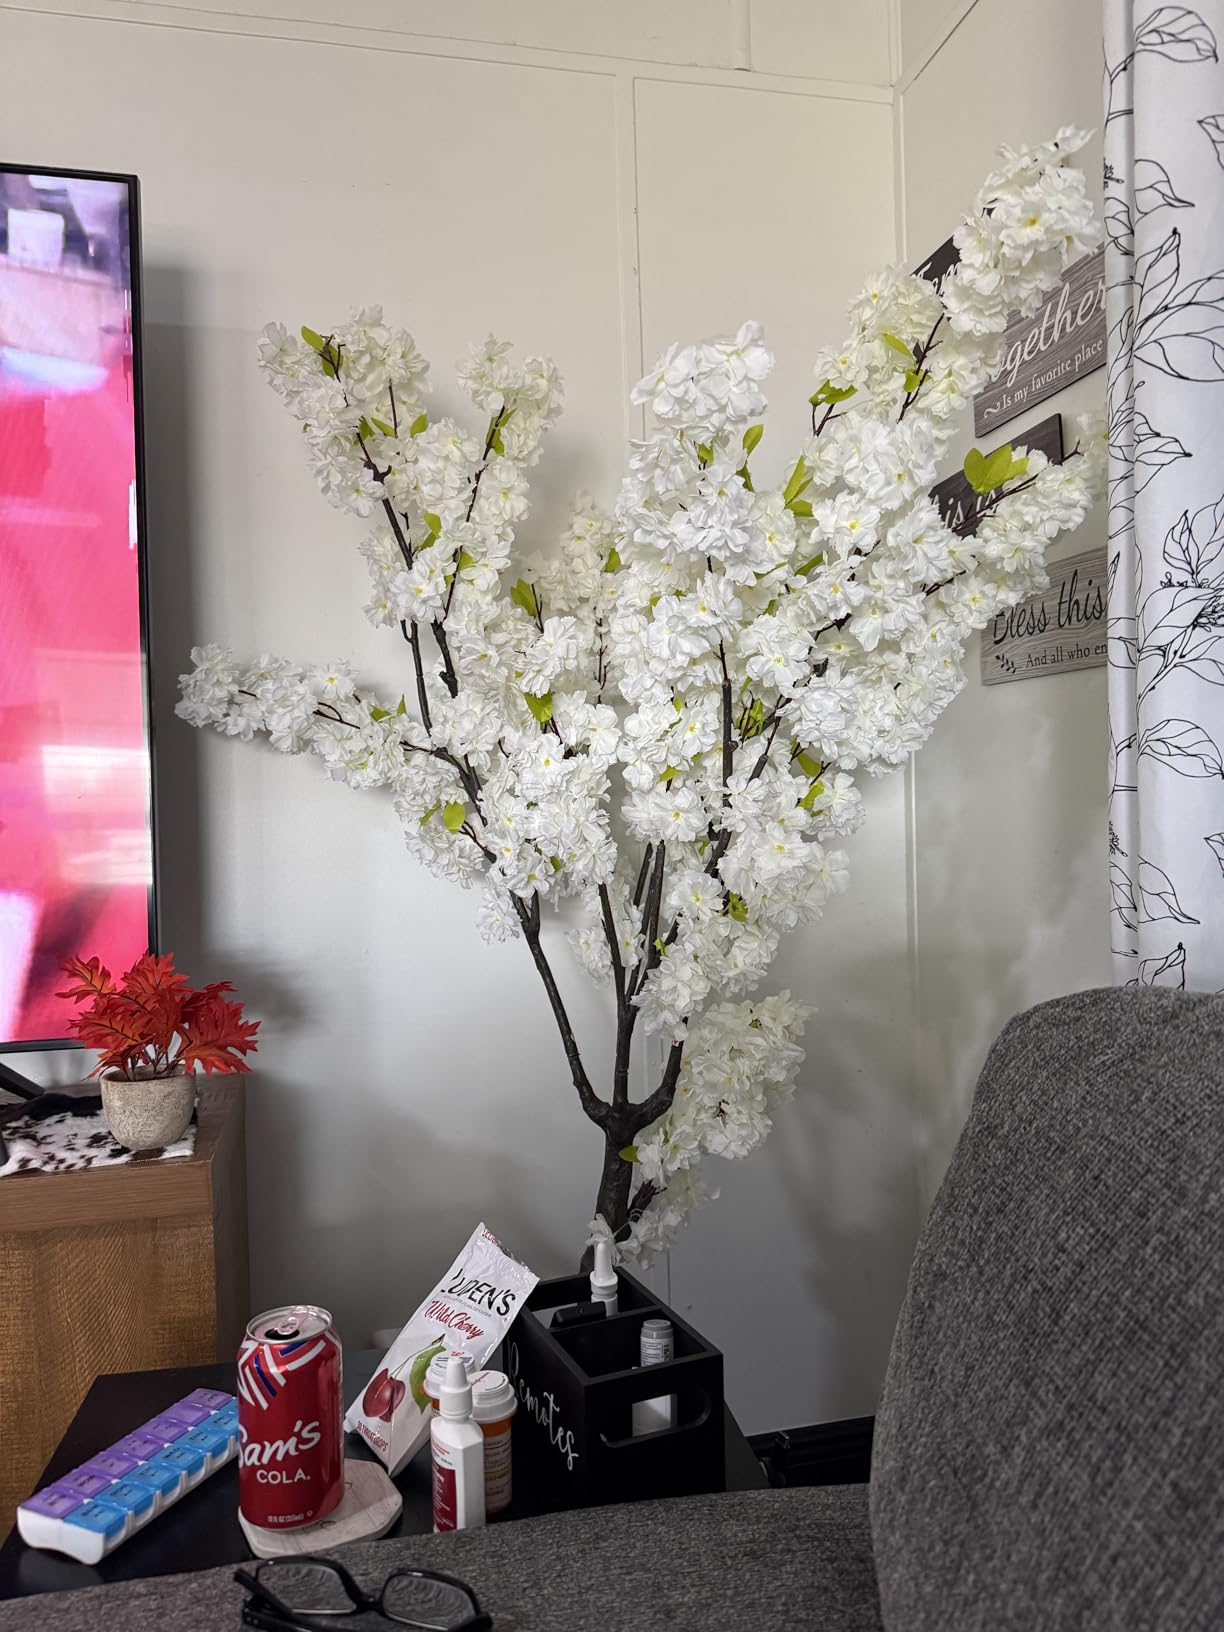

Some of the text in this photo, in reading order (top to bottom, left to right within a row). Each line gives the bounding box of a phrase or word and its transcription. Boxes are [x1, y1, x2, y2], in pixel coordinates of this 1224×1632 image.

[1002, 339, 1103, 409] Is my favorite place
[1058, 568, 1107, 629] this
[1026, 650, 1048, 668] And
[1051, 646, 1063, 664] all
[1067, 643, 1090, 660] who
[424, 1300, 455, 1326] Wild
[448, 1312, 485, 1340] Cherry
